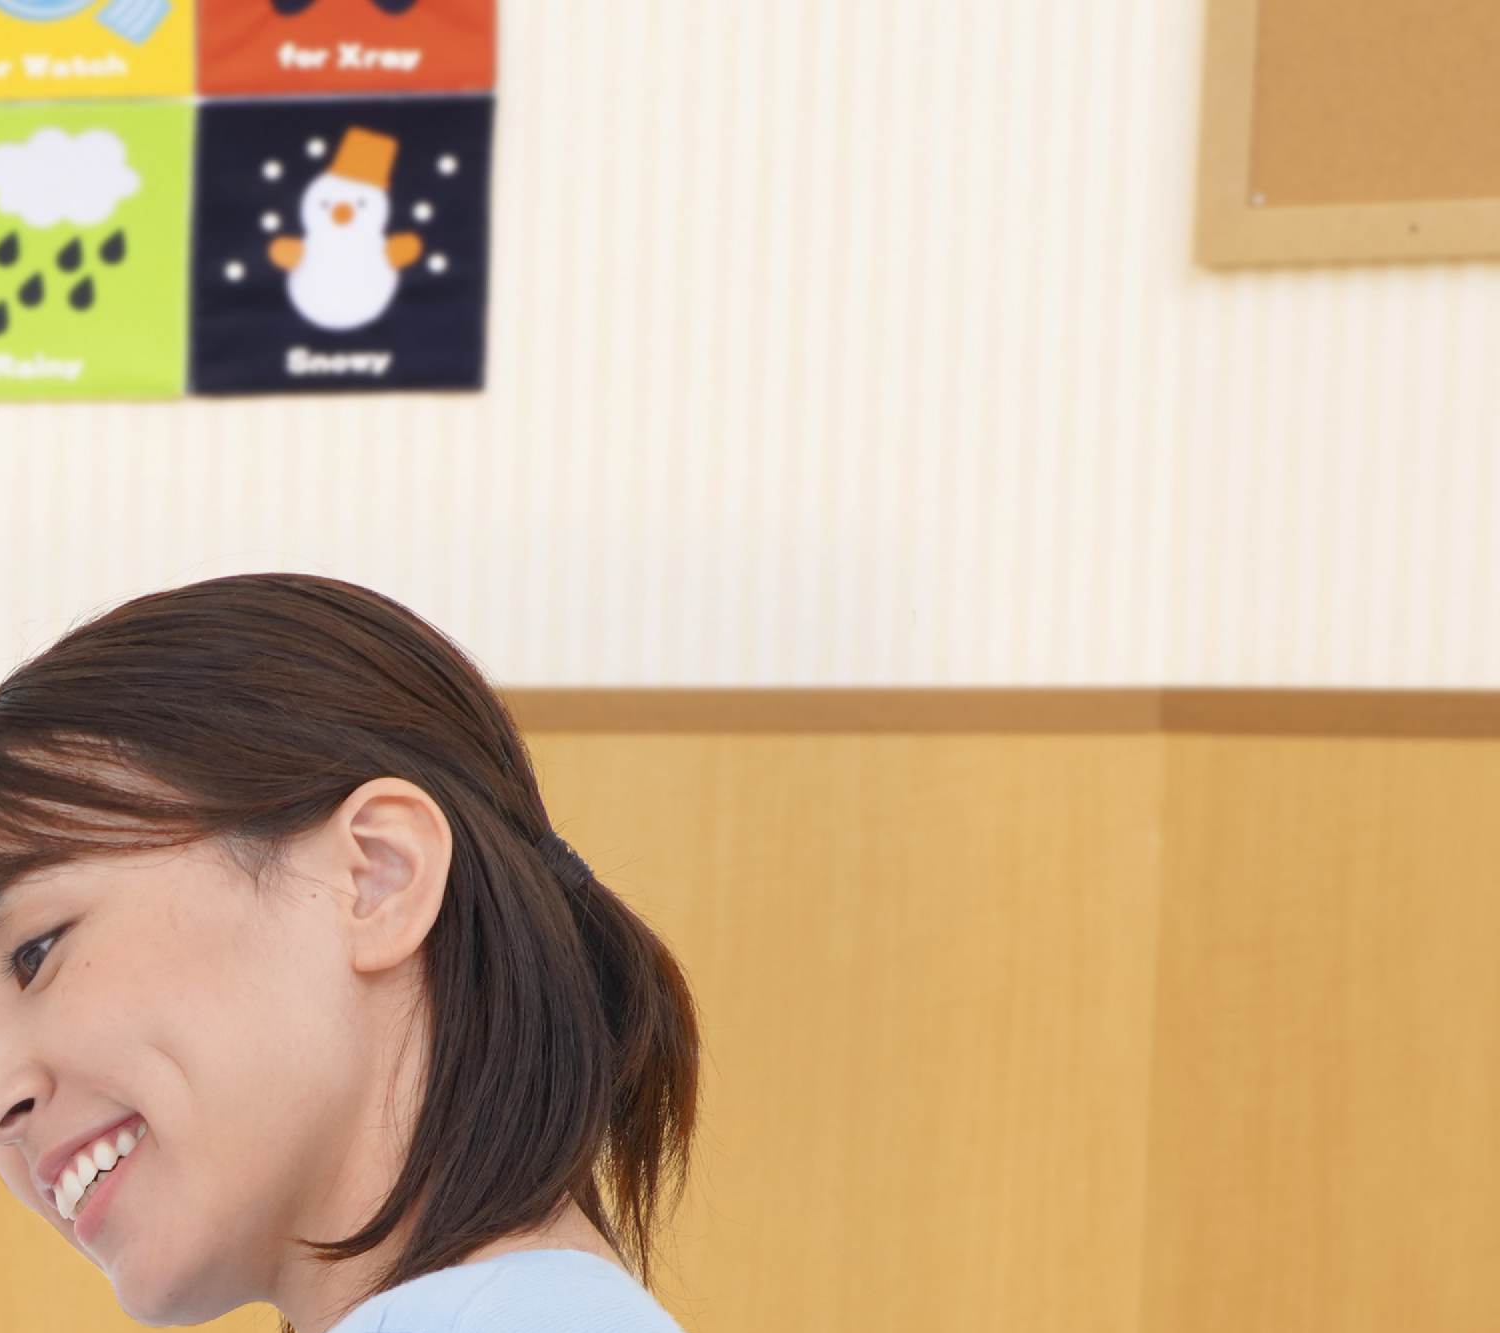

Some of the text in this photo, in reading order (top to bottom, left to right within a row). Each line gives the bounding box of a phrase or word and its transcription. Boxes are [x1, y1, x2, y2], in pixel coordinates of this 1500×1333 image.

[21, 52, 128, 79] Watch
[276, 41, 421, 72] for Xray
[285, 346, 391, 376] Snowy
